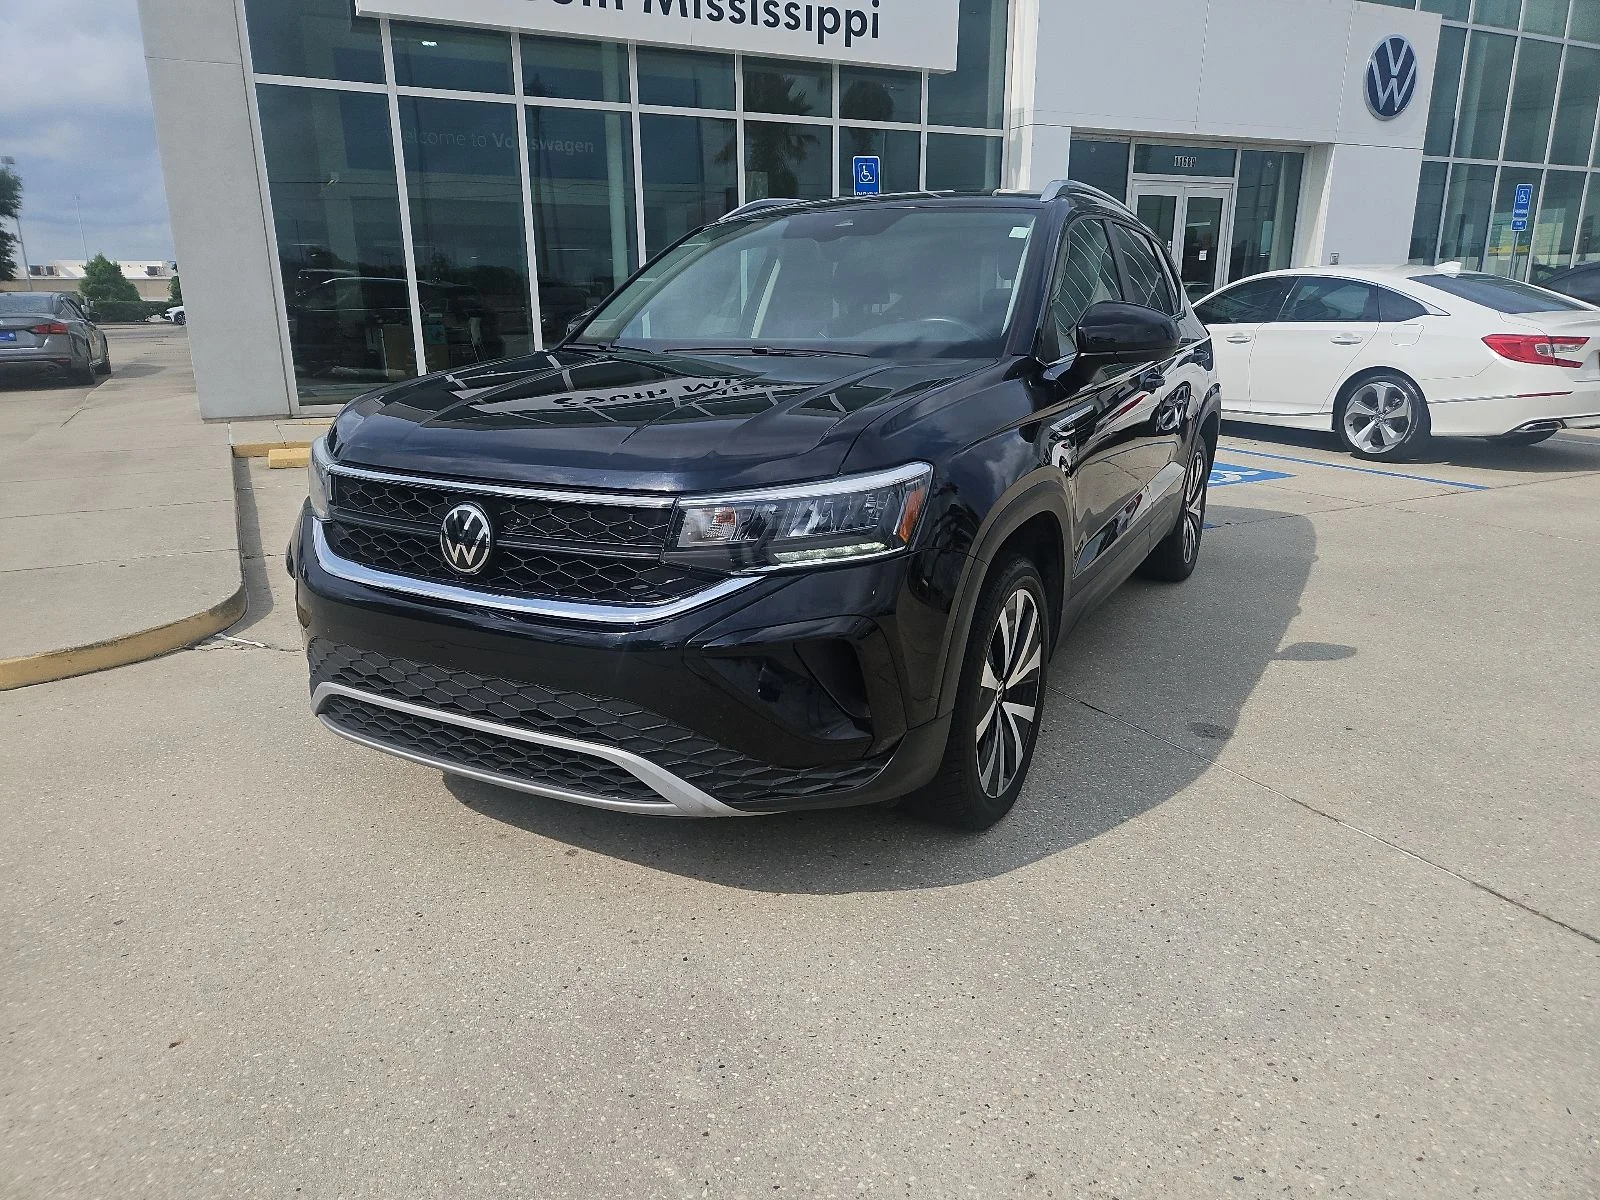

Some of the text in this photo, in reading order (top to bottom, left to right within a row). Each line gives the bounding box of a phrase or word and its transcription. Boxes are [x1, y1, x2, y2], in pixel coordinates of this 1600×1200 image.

[390, 126, 594, 156] elcome to Voswagen
